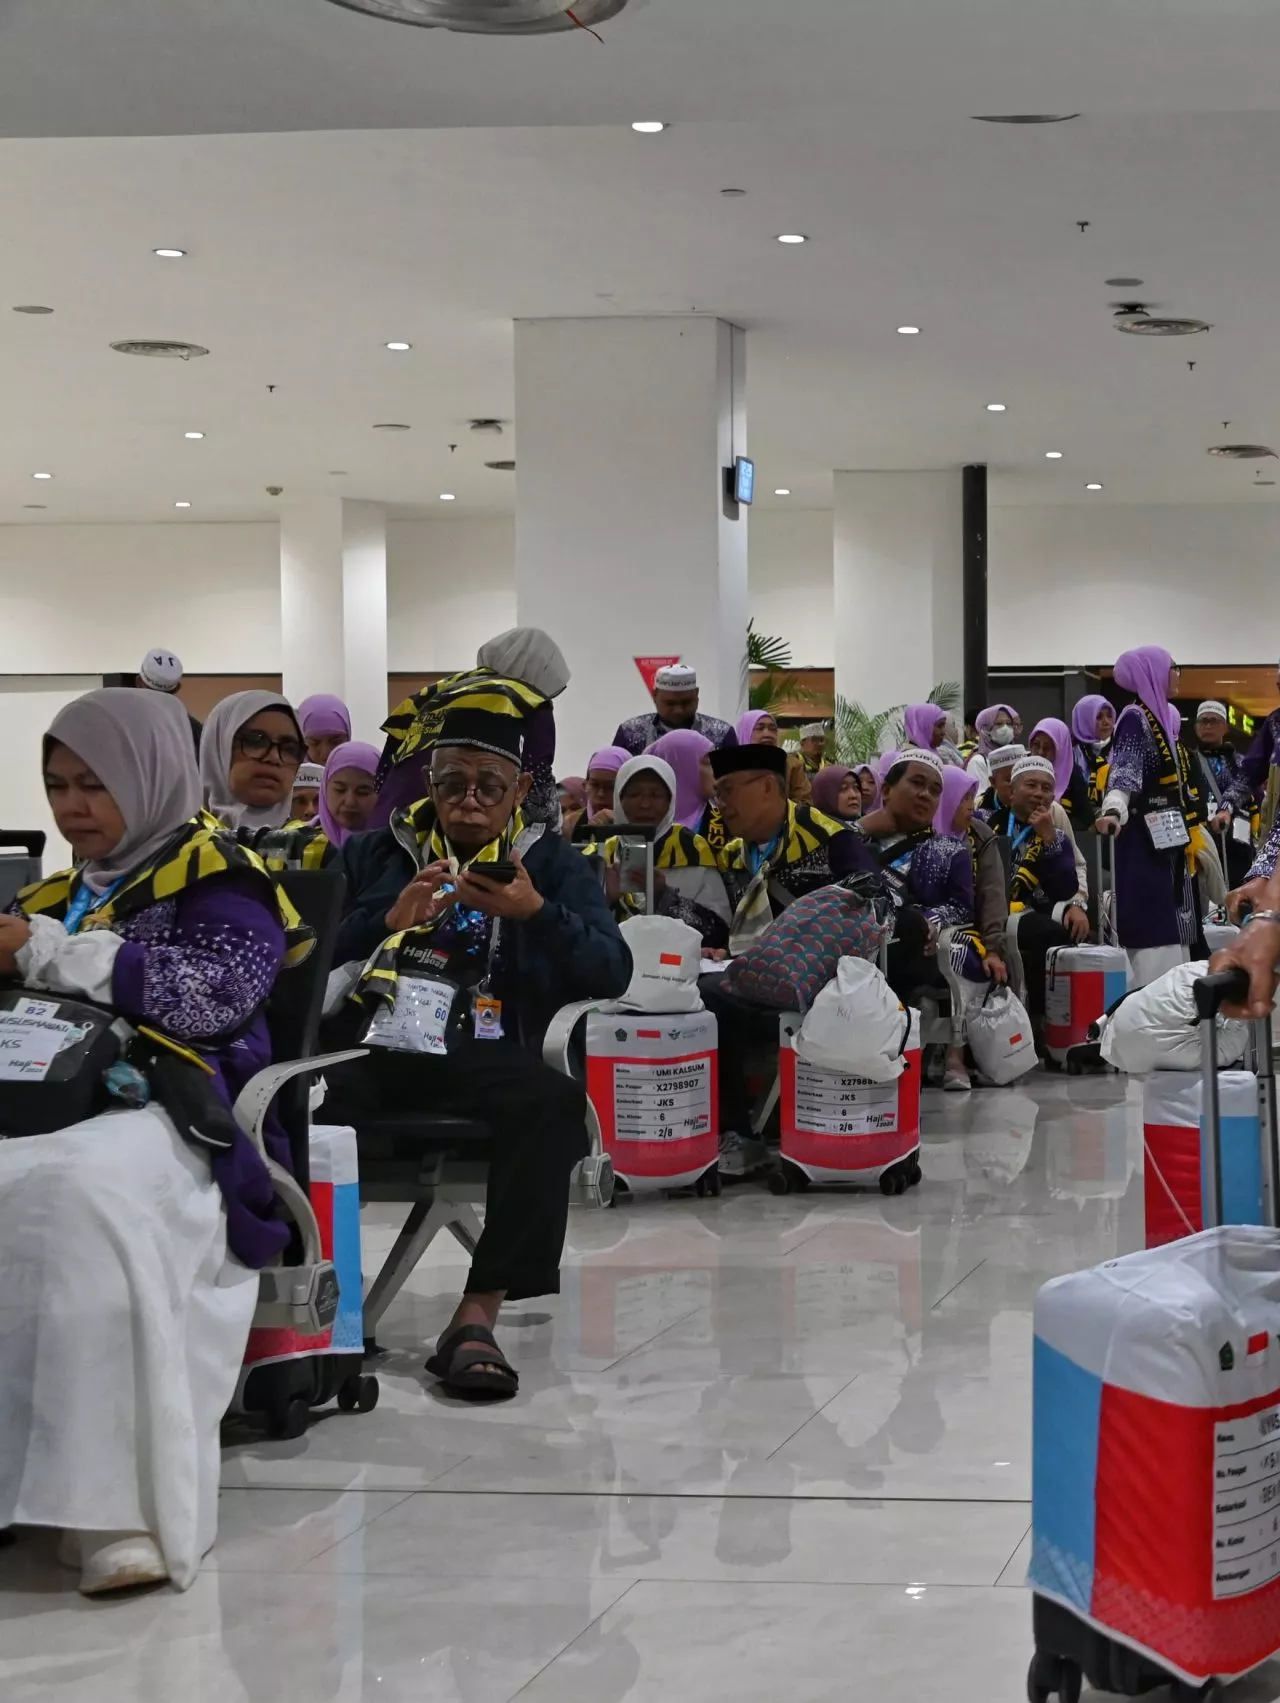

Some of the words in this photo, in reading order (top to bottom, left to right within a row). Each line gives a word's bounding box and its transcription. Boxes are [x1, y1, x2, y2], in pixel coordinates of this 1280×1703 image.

[403, 945, 434, 964] Haji
[434, 1007, 447, 1022] 60
[0, 1039, 22, 1048] KS
[656, 1068, 672, 1077] UMI
[673, 1063, 705, 1075] KALSUM
[840, 1093, 856, 1101] JKS
[656, 1098, 674, 1107] JKS
[659, 1113, 666, 1121] 6
[841, 1108, 847, 1117] 6
[839, 1123, 853, 1132] 2/8
[658, 1127, 673, 1138] 2/8
